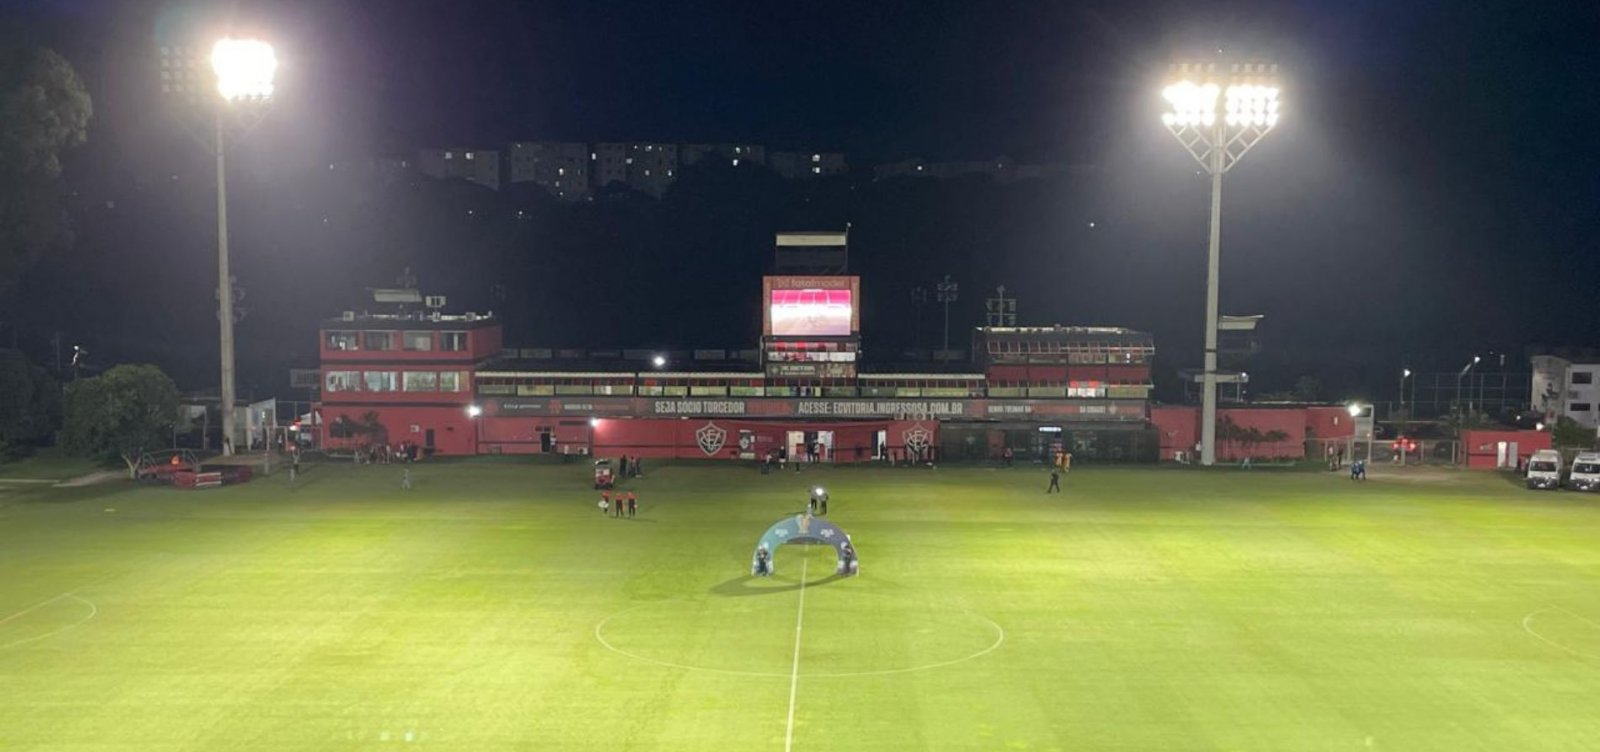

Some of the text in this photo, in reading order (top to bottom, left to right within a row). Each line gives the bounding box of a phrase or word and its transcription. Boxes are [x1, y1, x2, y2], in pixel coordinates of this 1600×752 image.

[655, 401, 676, 413] SEJA
[703, 401, 745, 413] TORCEDOR
[798, 402, 831, 414] ACESSE:
